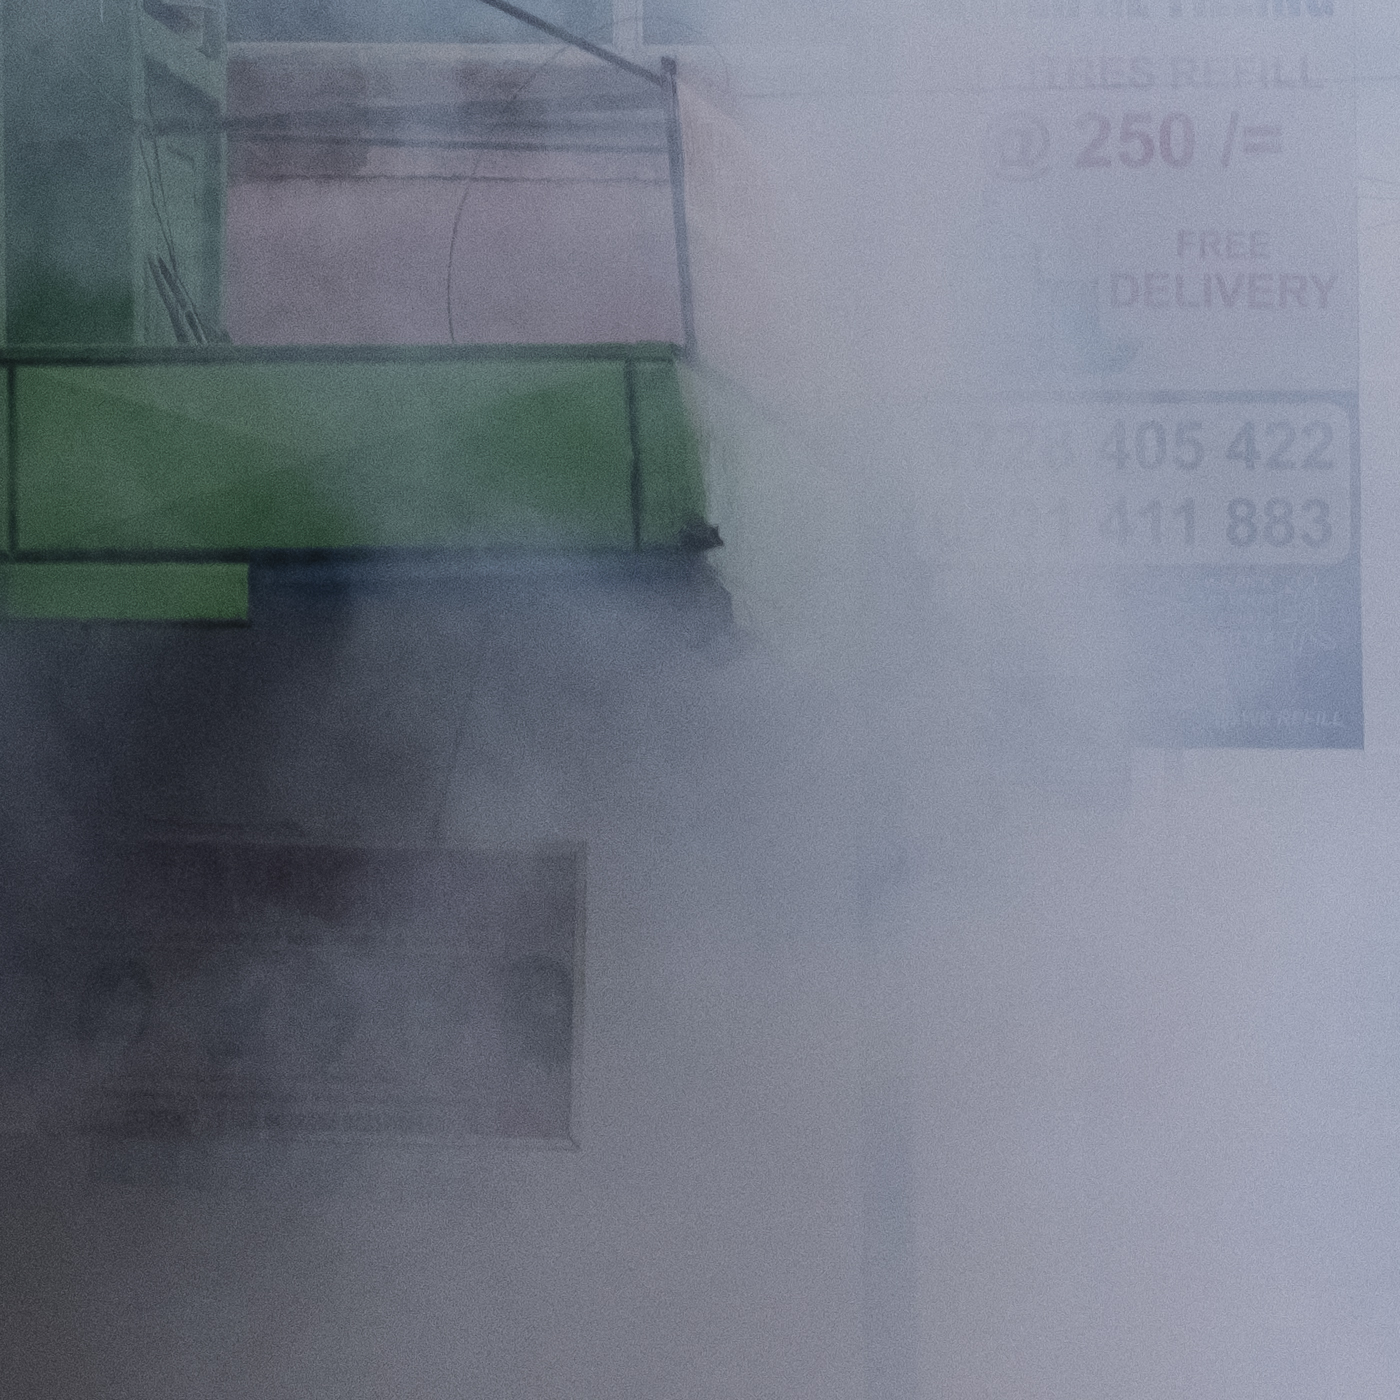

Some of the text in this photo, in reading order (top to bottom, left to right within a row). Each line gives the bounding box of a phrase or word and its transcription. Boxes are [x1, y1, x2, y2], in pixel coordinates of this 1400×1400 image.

[1170, 54, 1324, 90] REFILL
[1073, 110, 1197, 170] 250
[1175, 229, 1270, 260] FREE
[1109, 272, 1338, 311] DELIVERY
[1098, 419, 1205, 472] 405
[1225, 419, 1336, 472] 422
[1098, 496, 1197, 548] 411
[1225, 496, 1334, 548] 883
